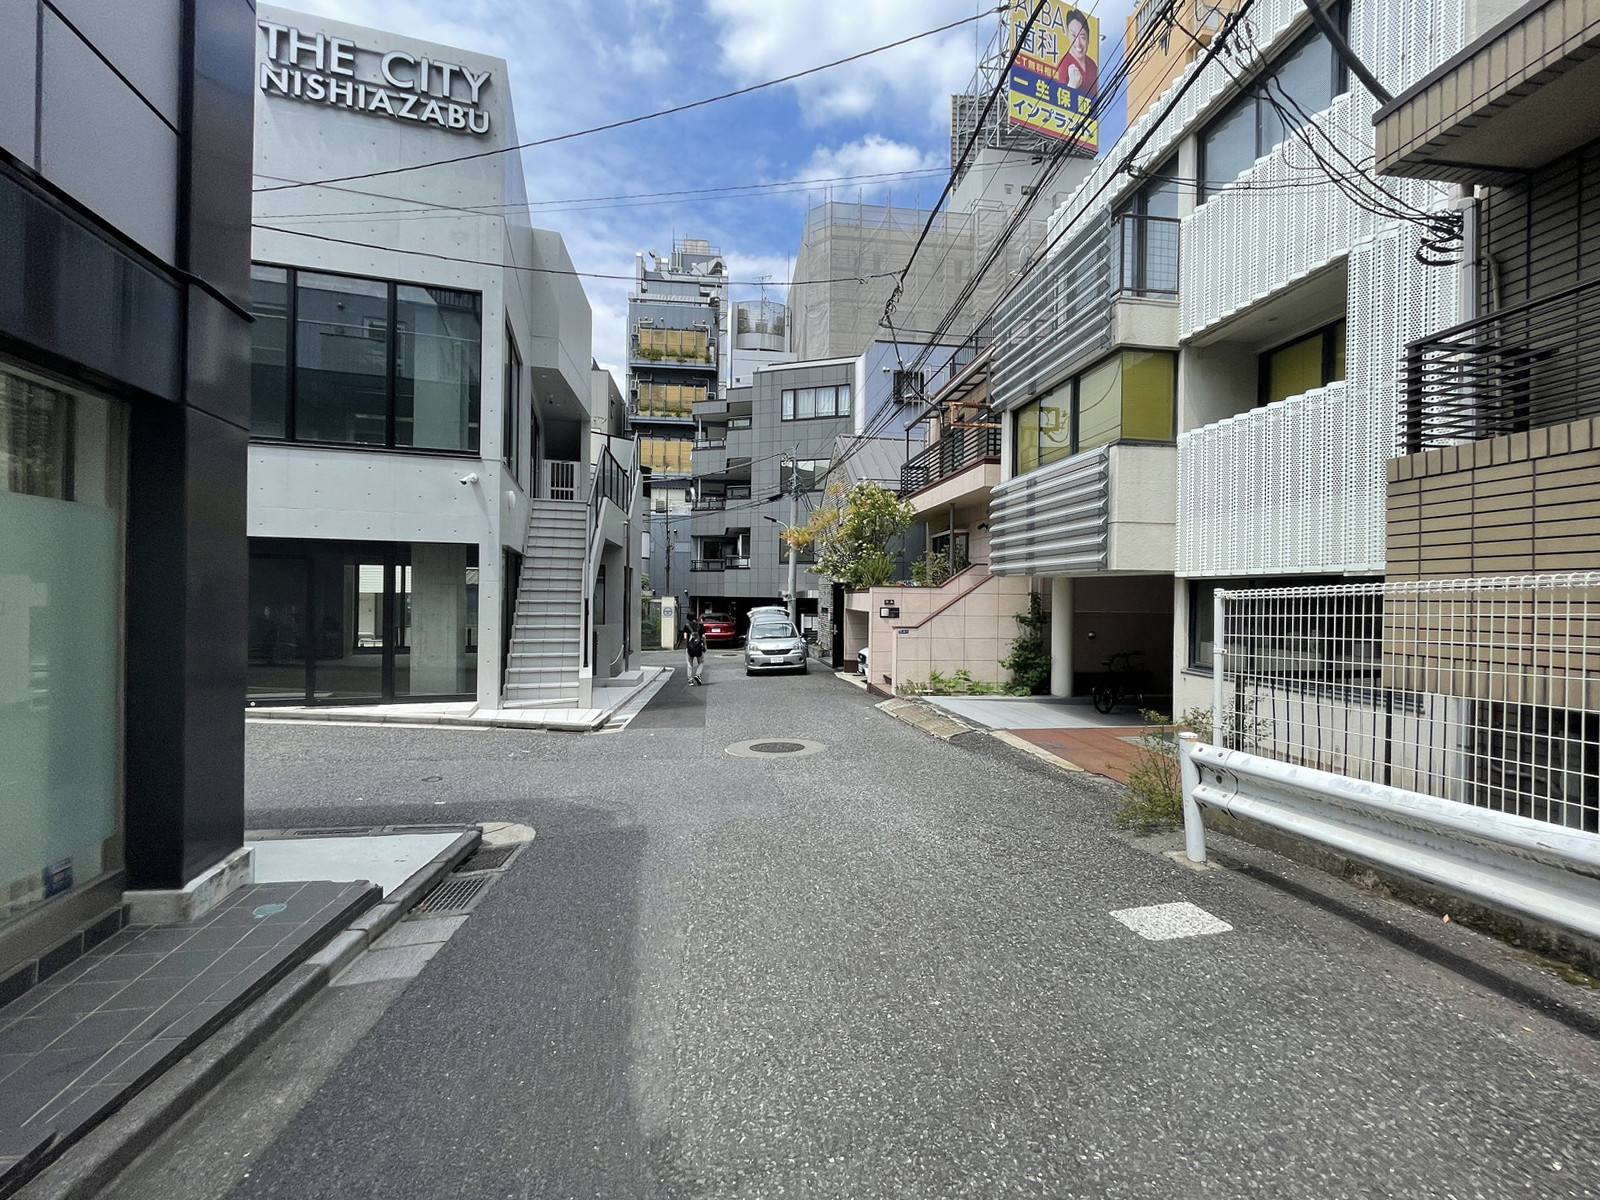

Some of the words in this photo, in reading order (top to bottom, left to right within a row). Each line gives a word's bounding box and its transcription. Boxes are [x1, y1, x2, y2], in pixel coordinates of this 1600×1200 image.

[258, 19, 355, 76] THE
[381, 50, 491, 104] CITY
[1015, 20, 1059, 63] 歯科
[260, 63, 489, 134] NISHIAZABU
